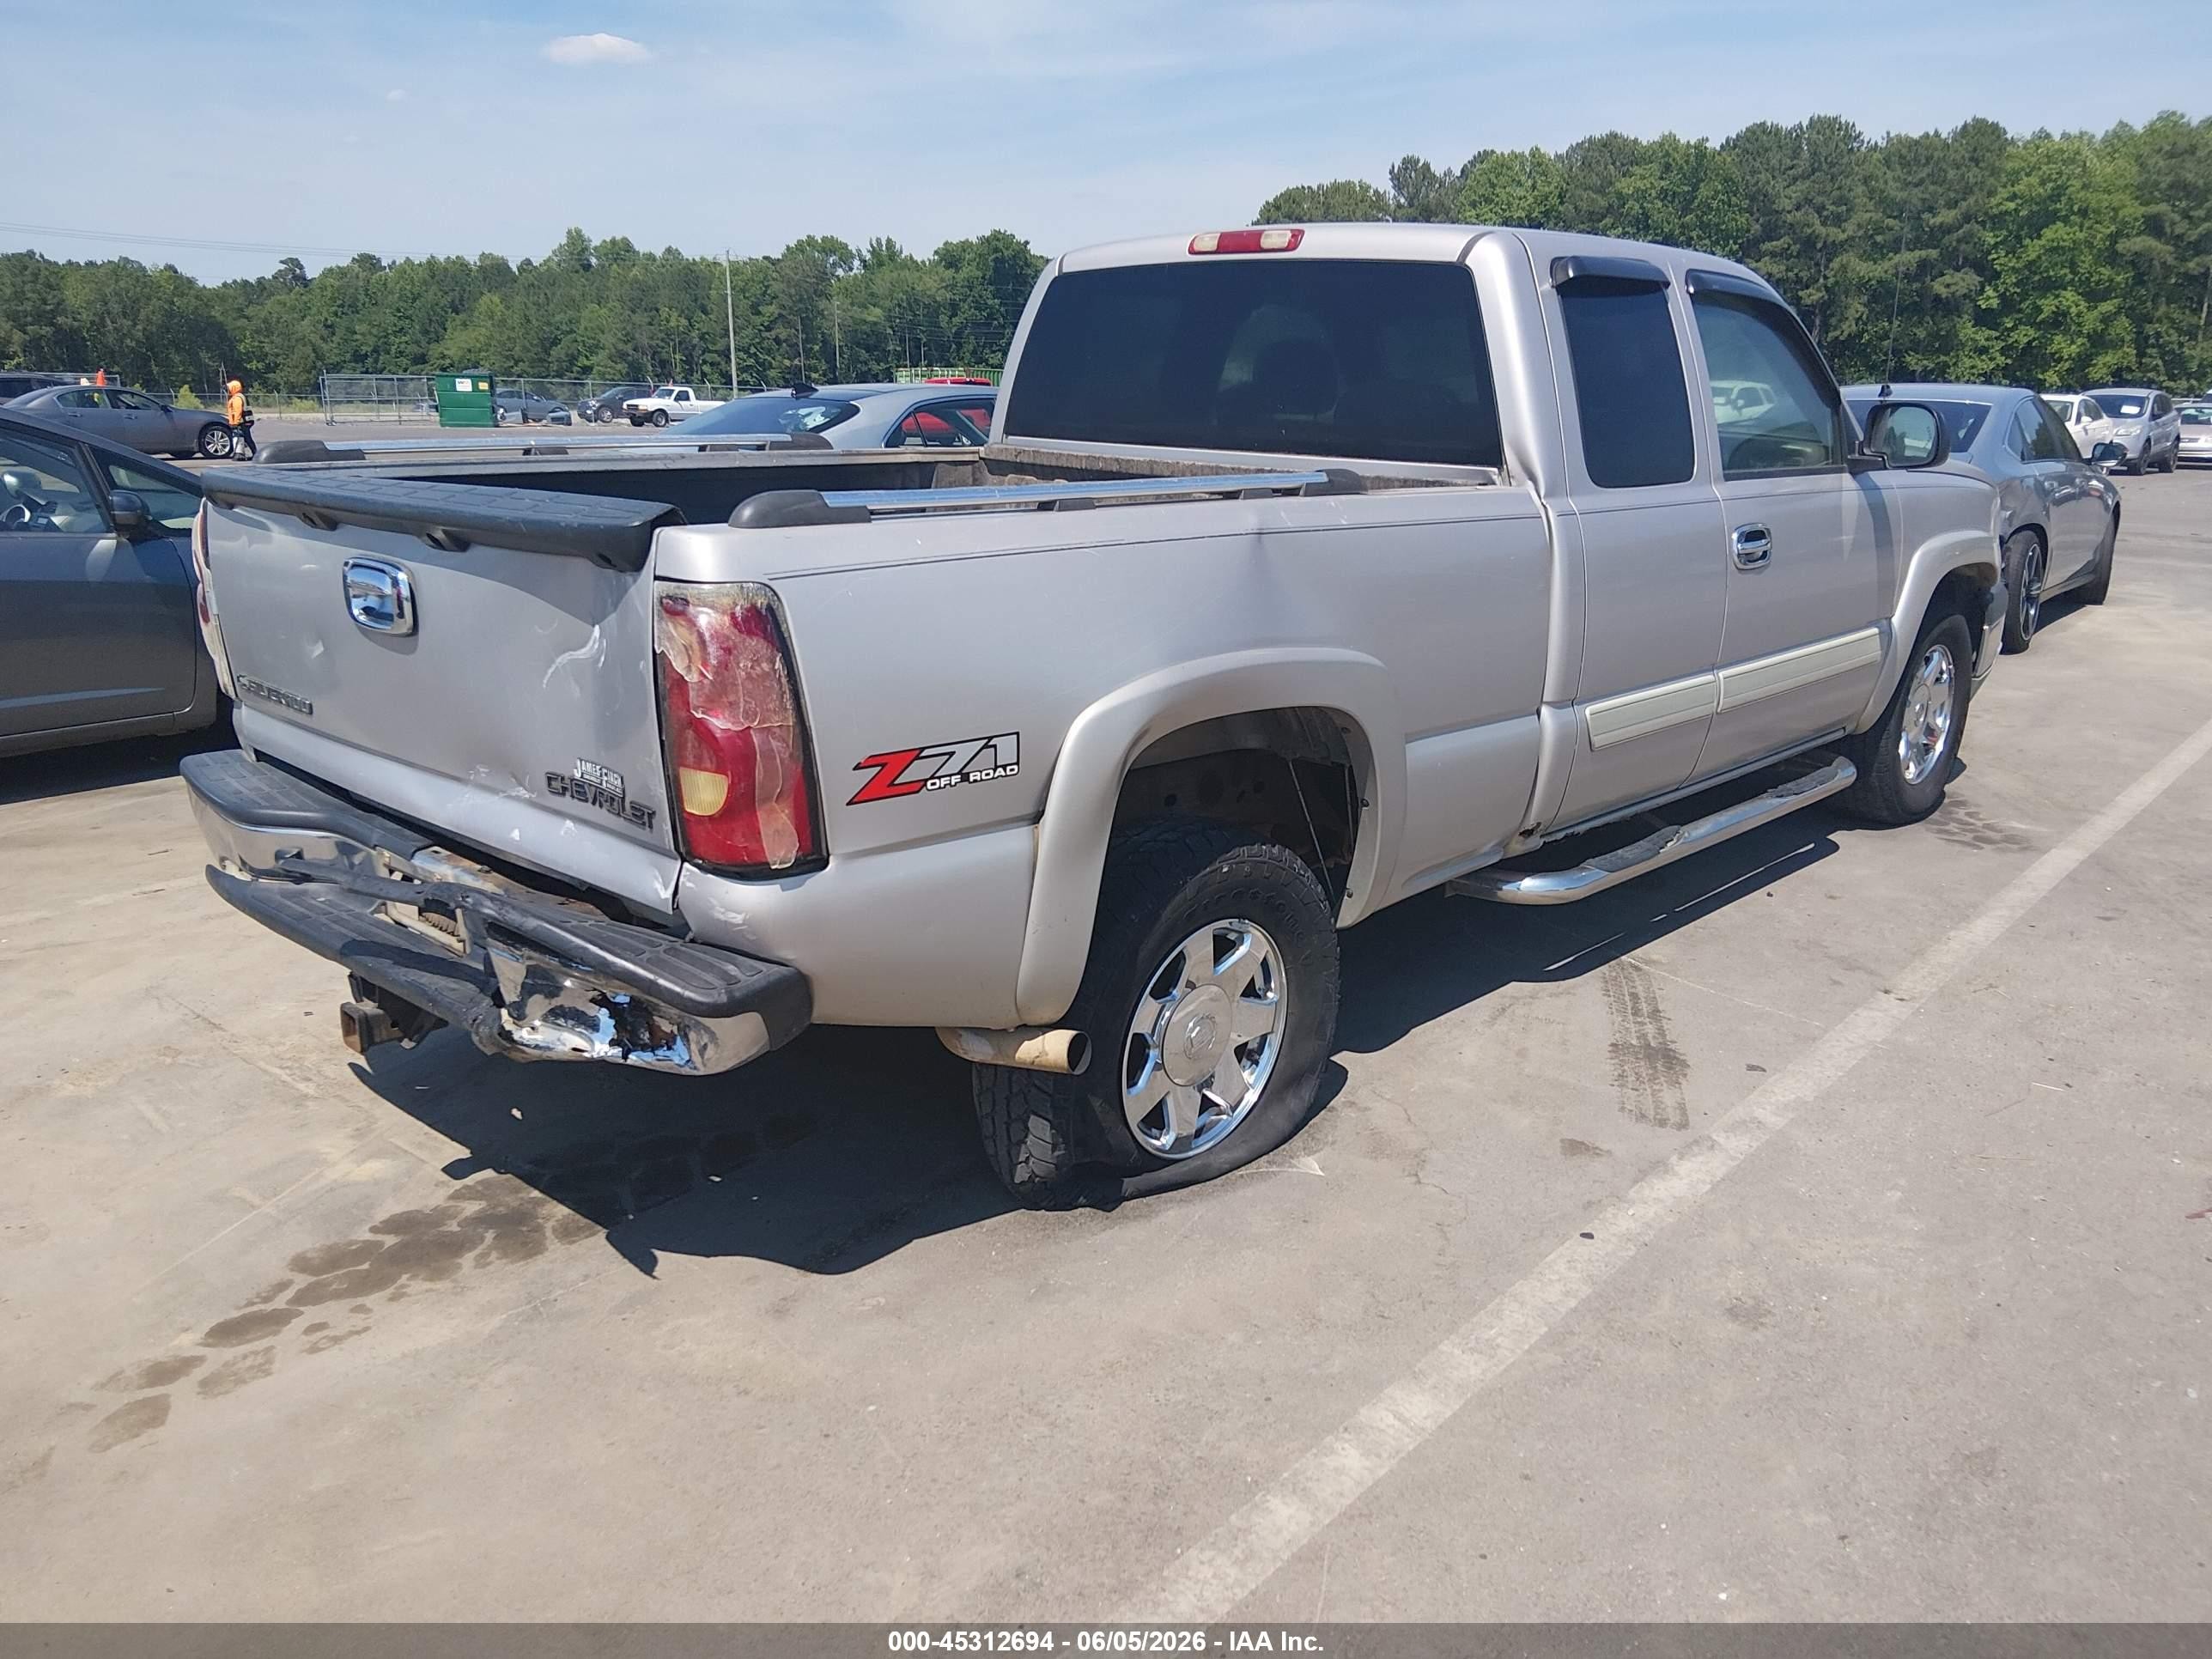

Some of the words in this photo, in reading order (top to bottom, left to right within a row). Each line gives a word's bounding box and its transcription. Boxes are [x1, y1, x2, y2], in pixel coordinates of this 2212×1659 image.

[846, 731, 1019, 805] Z71
[926, 775, 962, 791] OFF
[969, 765, 1018, 783] ROAD
[545, 772, 656, 830] CHEVROLET
